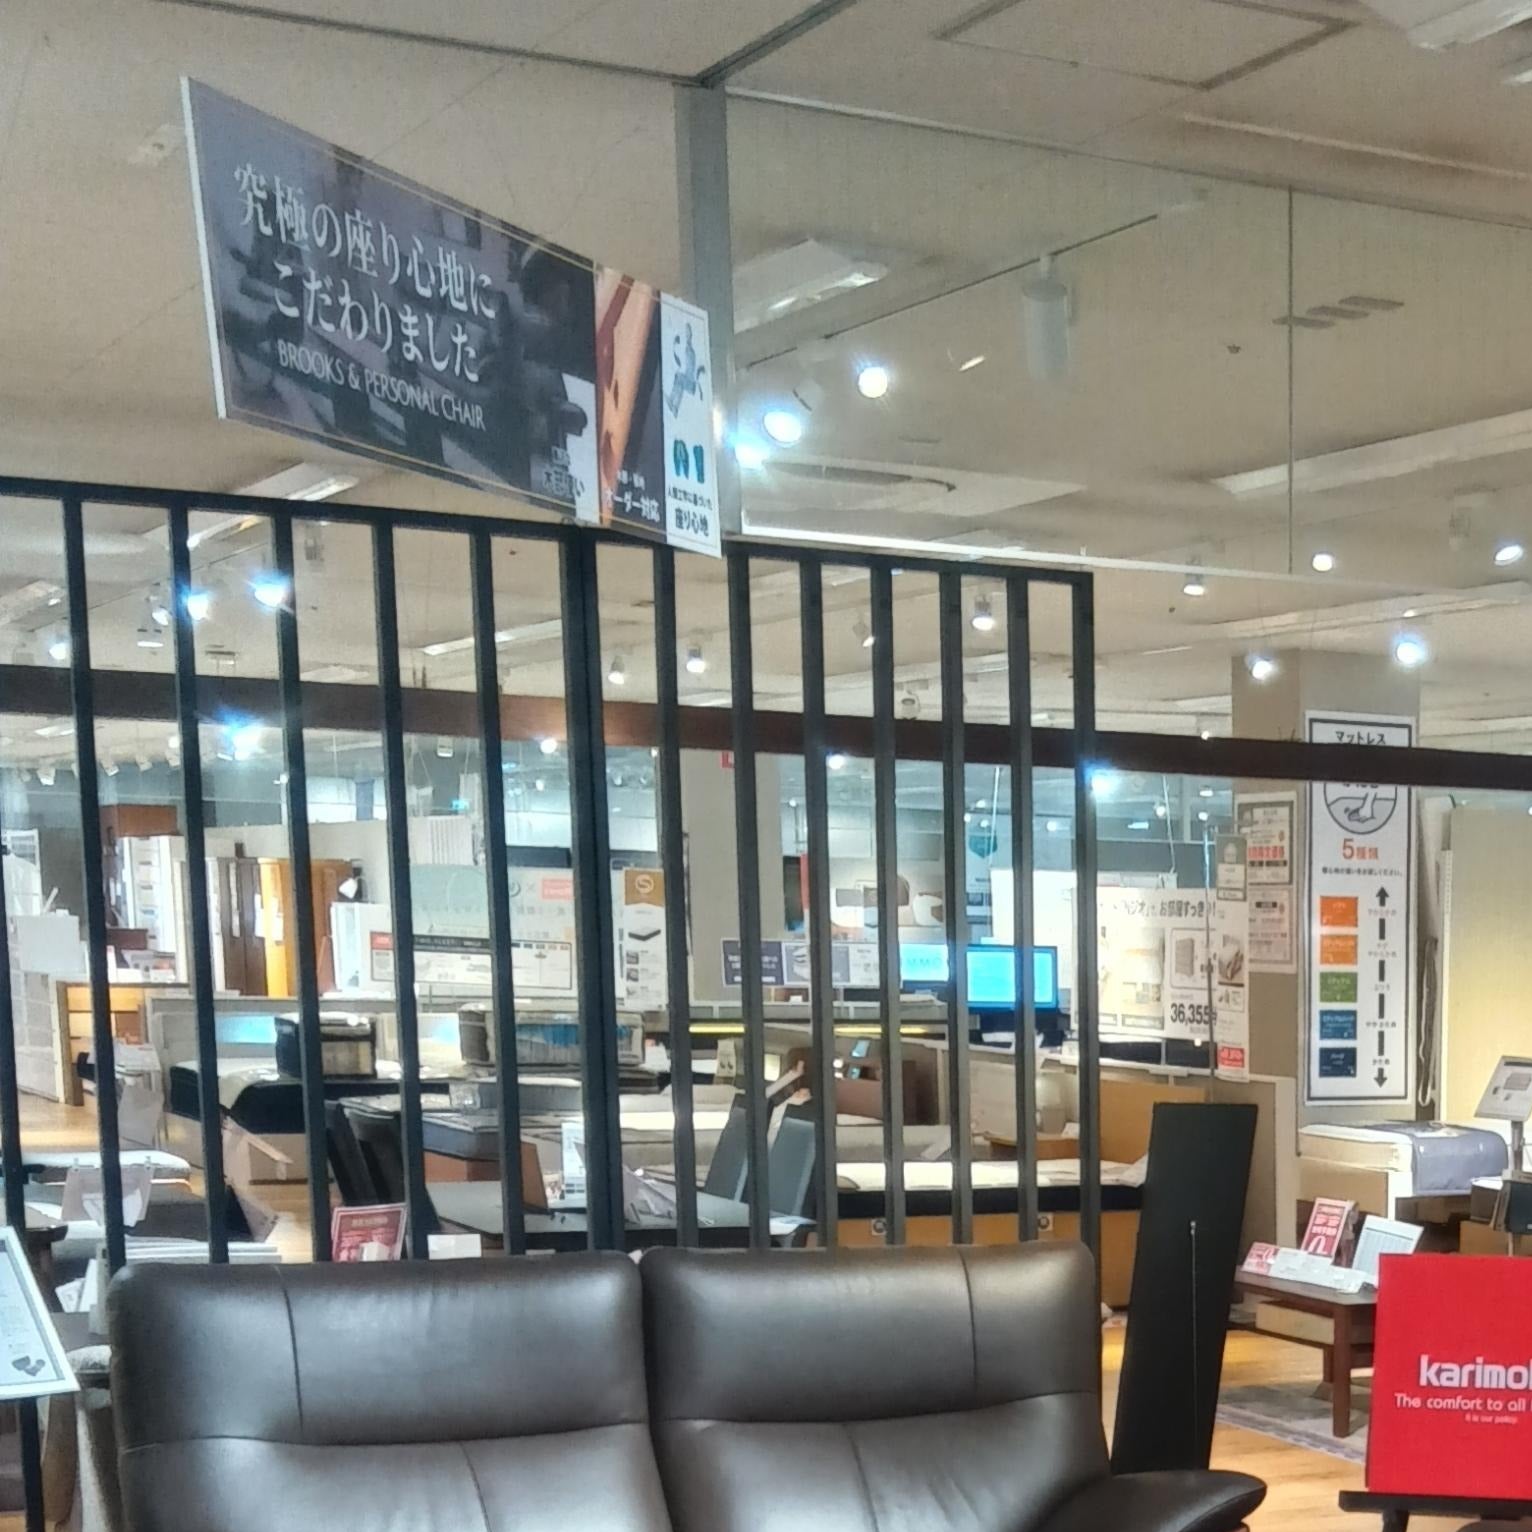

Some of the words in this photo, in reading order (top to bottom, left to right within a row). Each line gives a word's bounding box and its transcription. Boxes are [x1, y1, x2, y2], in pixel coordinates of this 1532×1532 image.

[234, 163, 495, 319] 究極の座り心地に
[274, 260, 480, 383] こだわりました
[277, 339, 345, 386] BROOKS
[348, 368, 360, 390] &
[364, 367, 439, 417] PERSONAL
[441, 394, 486, 431] CHAIR
[675, 508, 710, 537] 座り心地
[1336, 731, 1386, 745] マットレス
[1395, 1392, 1421, 1409] The
[1427, 1394, 1482, 1410] comfort
[1487, 1396, 1504, 1412] to
[1508, 1397, 1525, 1412] all
